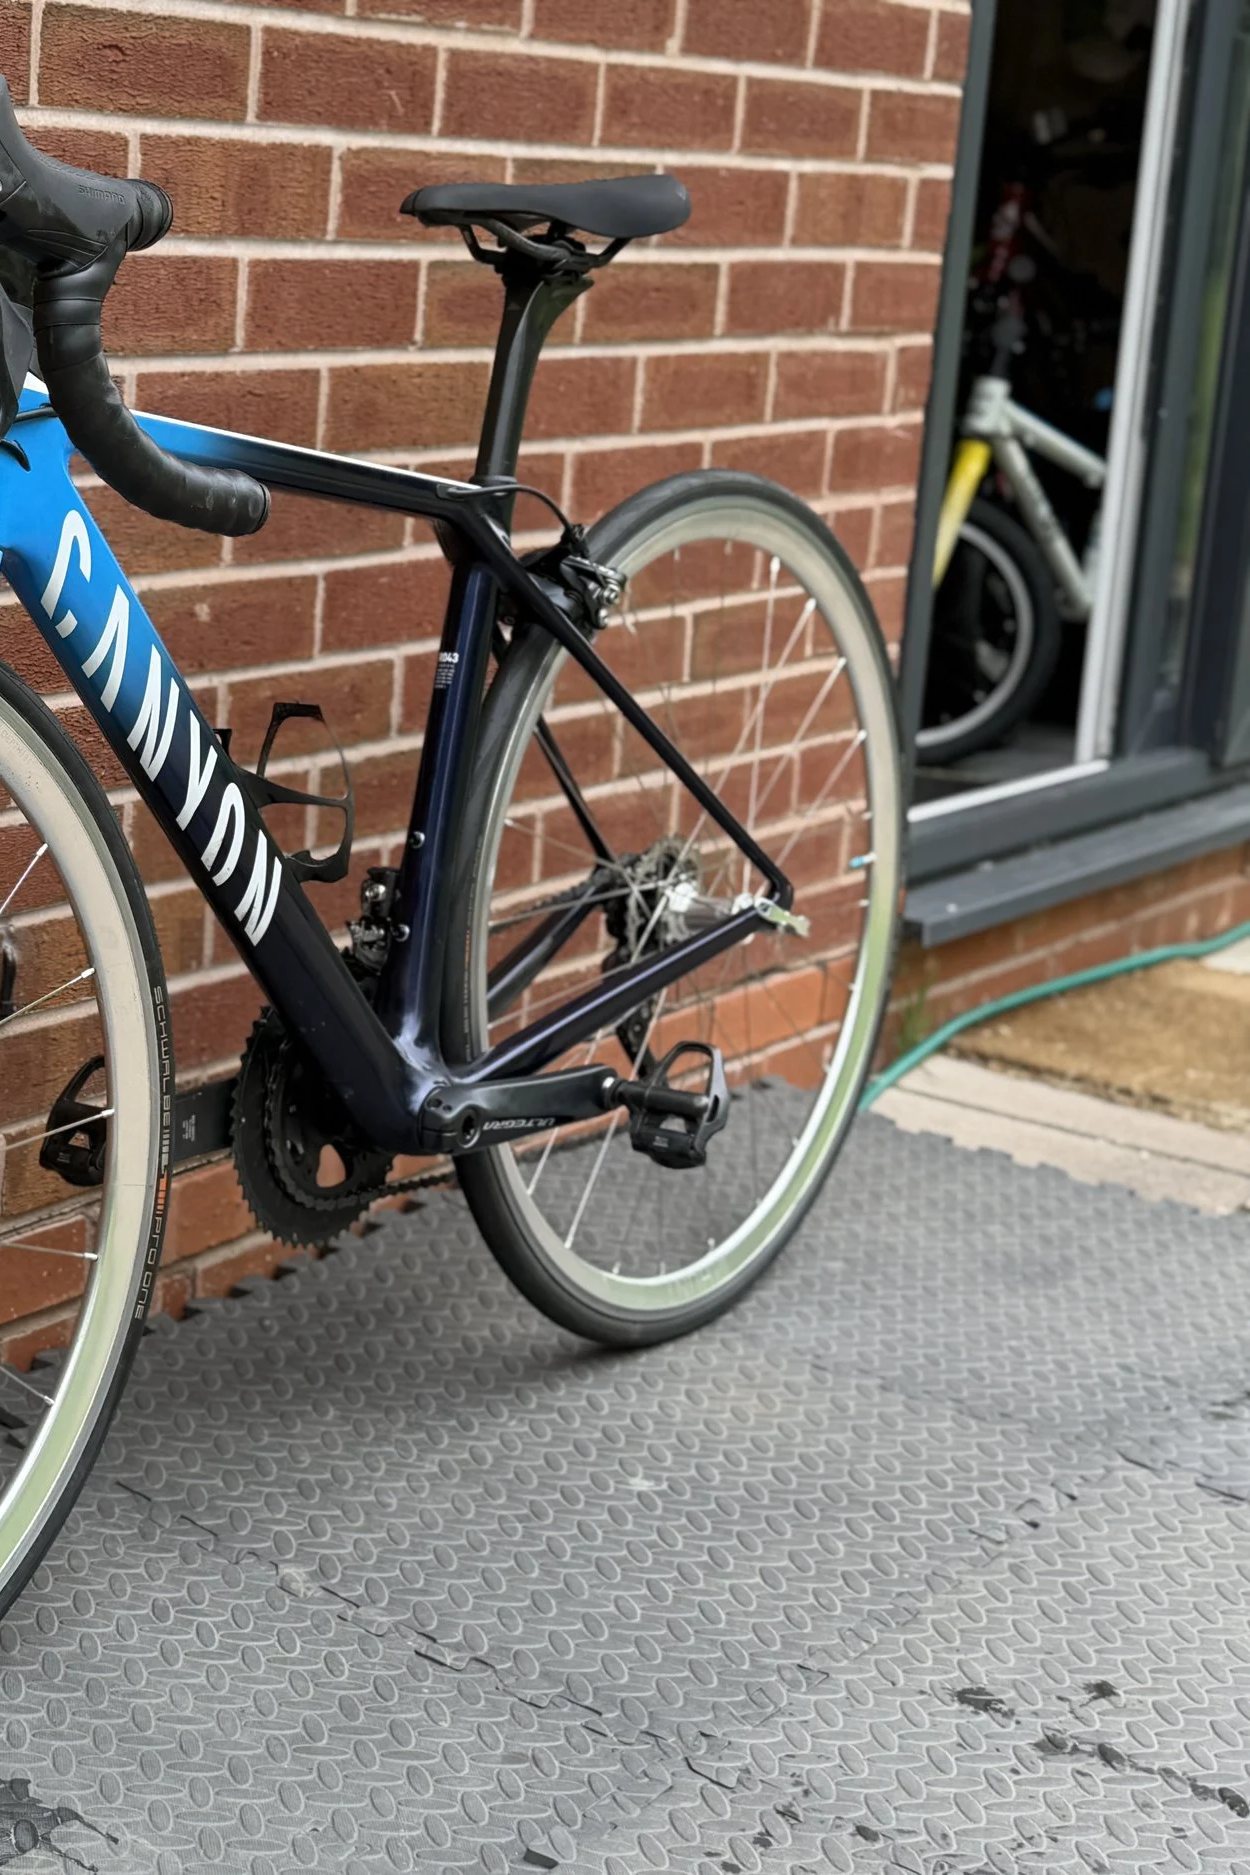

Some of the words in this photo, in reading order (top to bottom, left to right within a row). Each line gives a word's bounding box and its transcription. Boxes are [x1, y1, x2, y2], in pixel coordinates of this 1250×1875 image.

[41, 509, 282, 947] CANYON
[153, 986, 171, 1127] SCHWALBE
[482, 1117, 556, 1131] ULTEGRA
